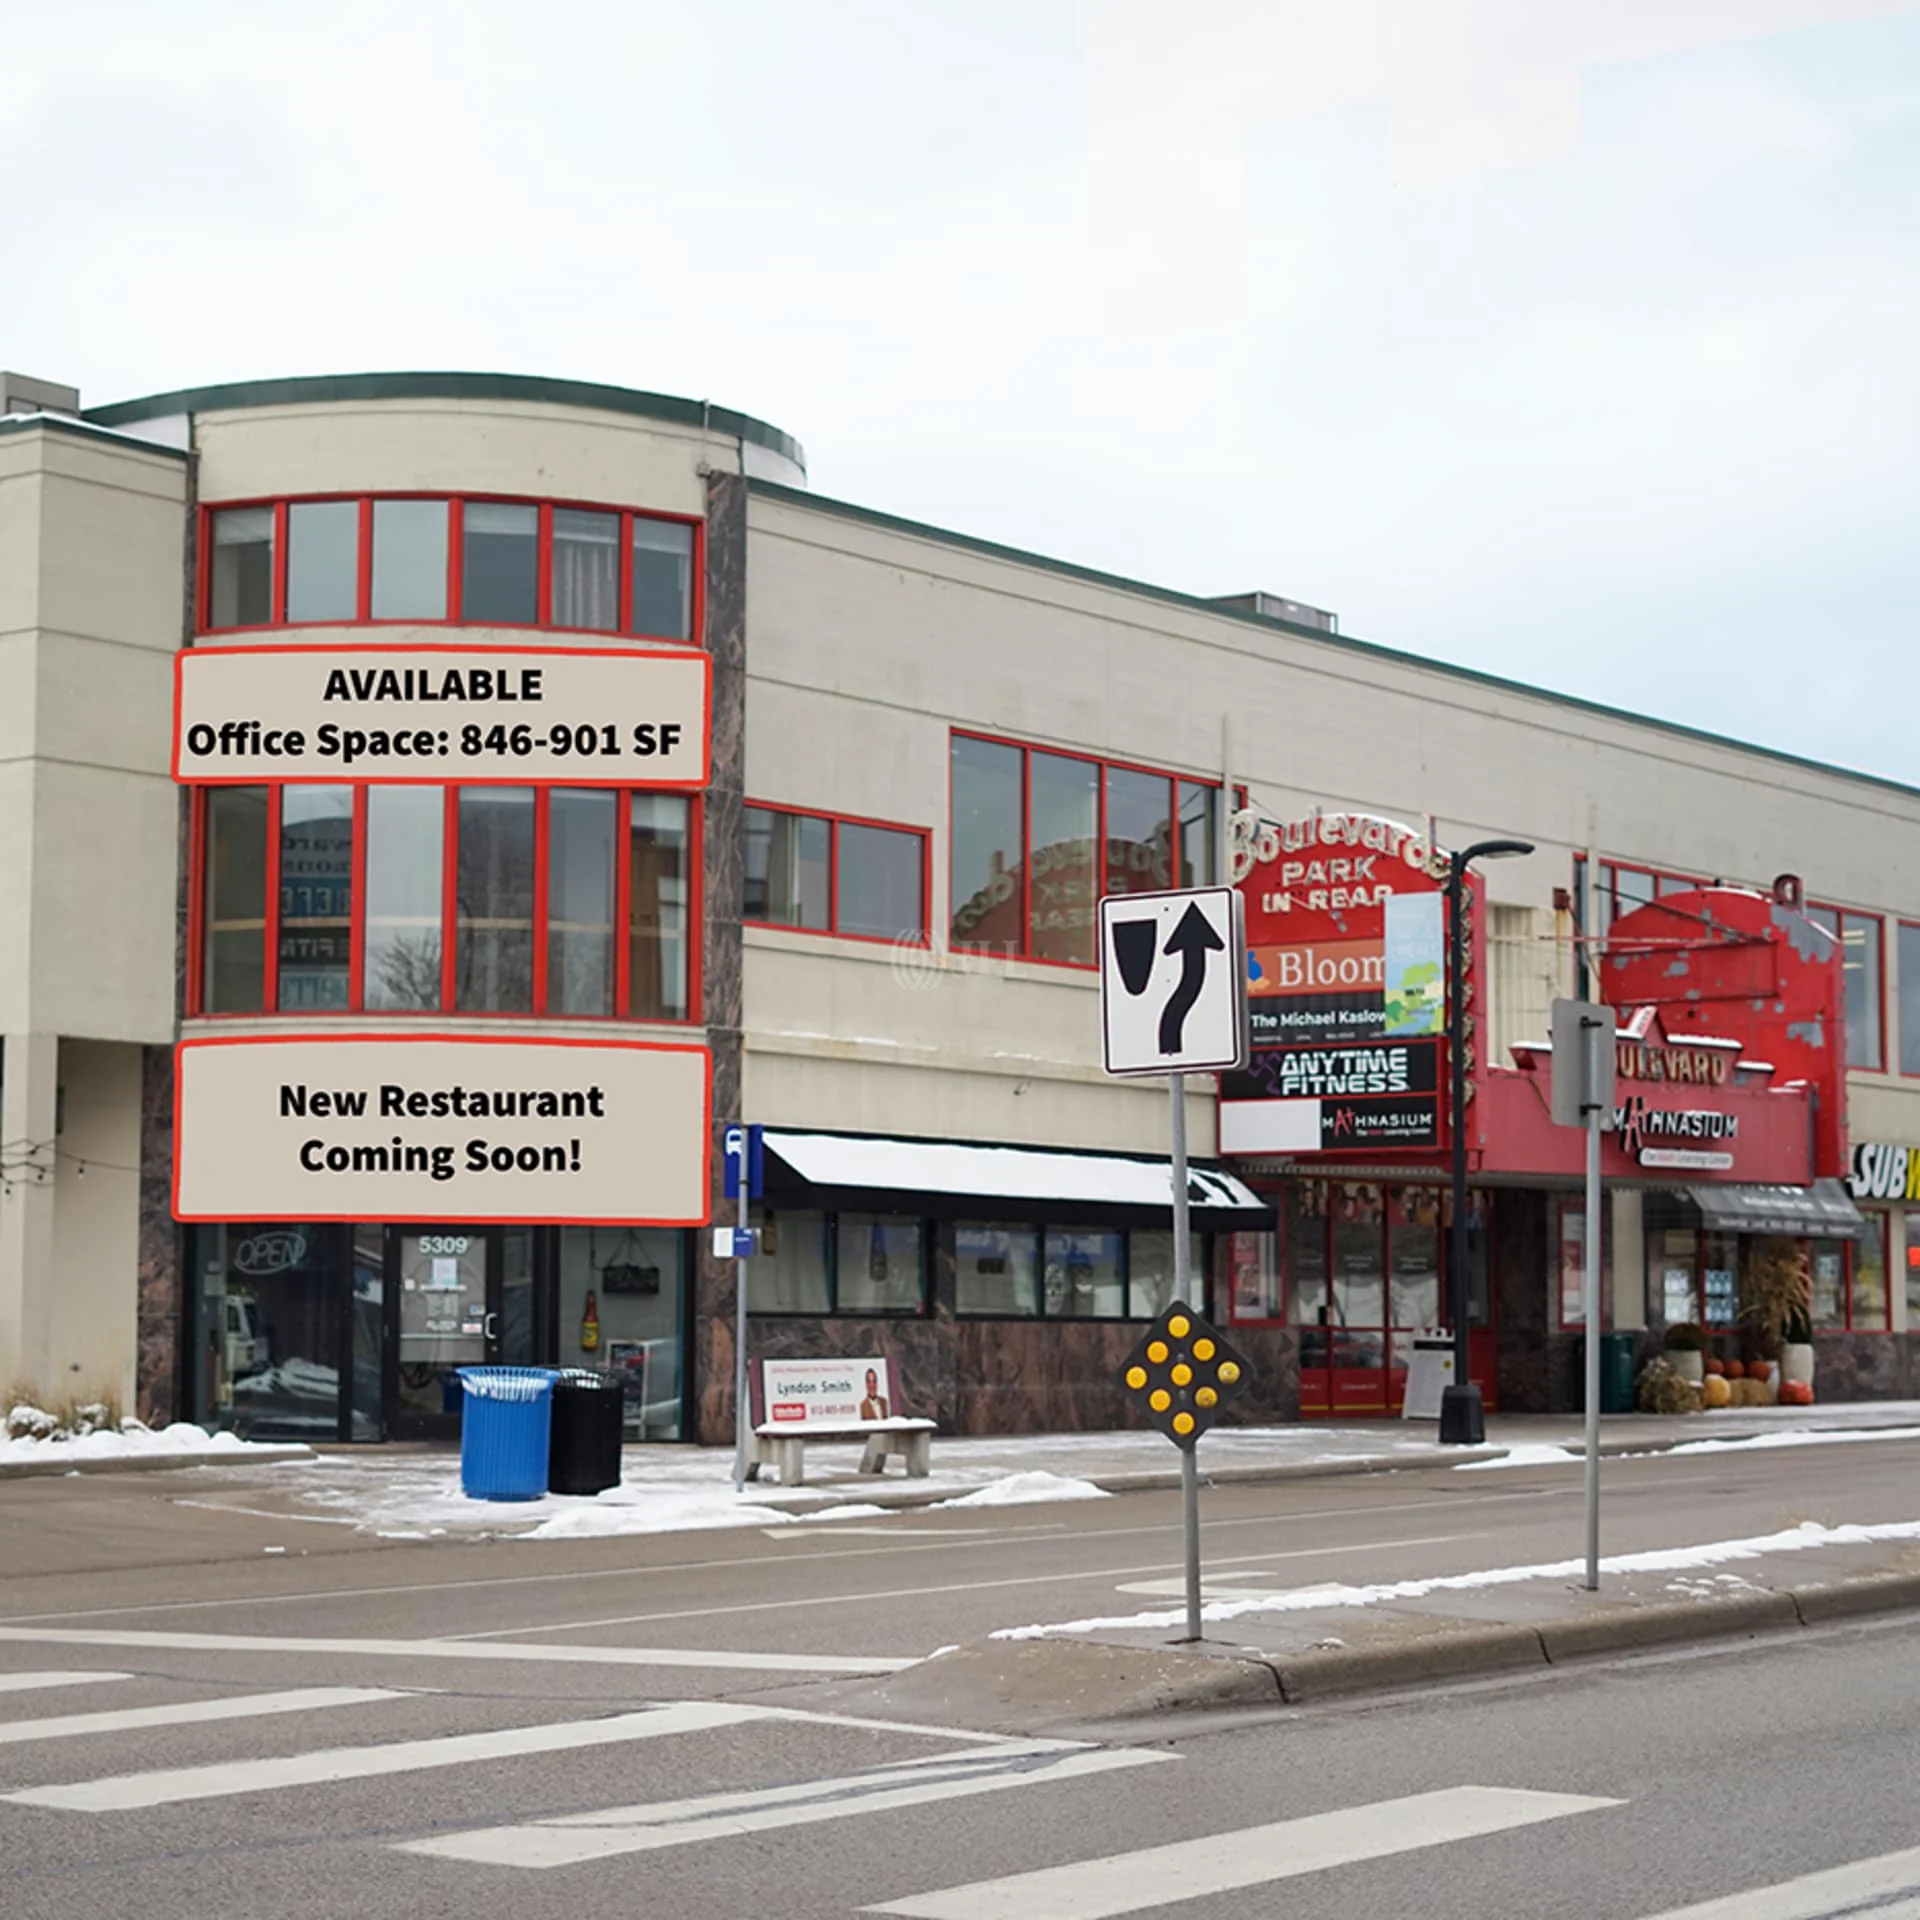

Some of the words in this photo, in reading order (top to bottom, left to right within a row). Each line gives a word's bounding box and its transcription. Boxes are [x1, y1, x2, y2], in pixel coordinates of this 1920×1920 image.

[1229, 806, 1440, 886] Boulevard
[1281, 855, 1376, 888] PARK
[1262, 892, 1292, 913] IN
[1278, 949, 1386, 988] Bloom
[1251, 1014, 1278, 1029] The
[1281, 1011, 1336, 1027] Michael
[1279, 1048, 1408, 1077] ANYTIME
[1619, 1045, 1726, 1085] ULEVARD
[1282, 1073, 1408, 1096] FITNESS
[237, 1238, 301, 1267] OPEN
[419, 1235, 468, 1255] 5309
[776, 1381, 817, 1397] Lyndon
[821, 1380, 853, 1394] Smith
